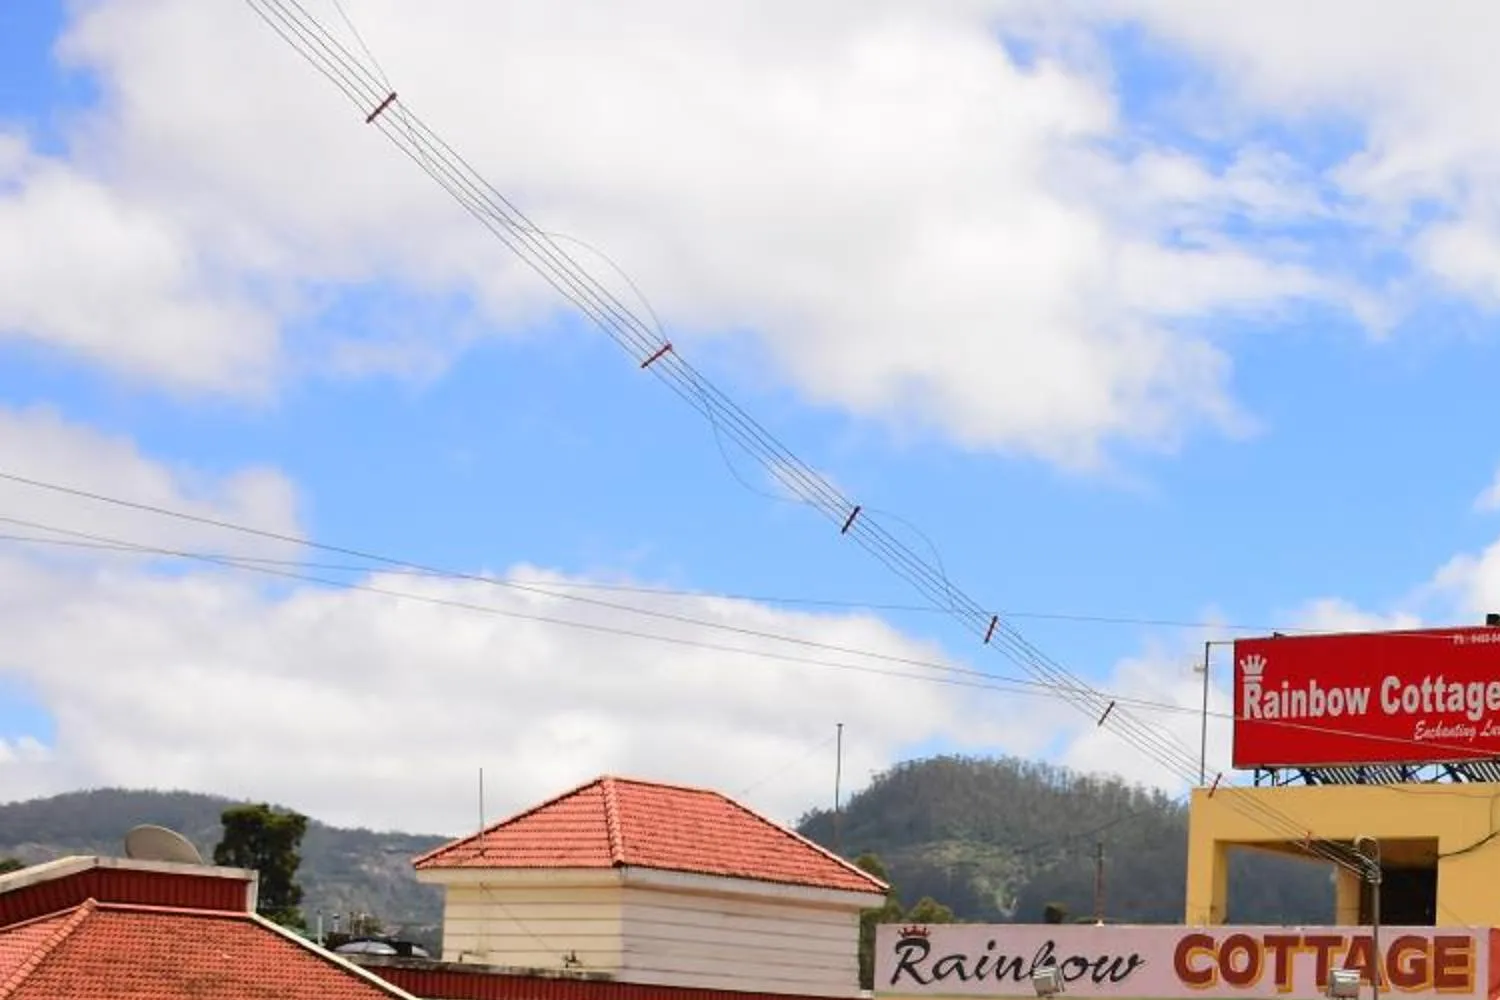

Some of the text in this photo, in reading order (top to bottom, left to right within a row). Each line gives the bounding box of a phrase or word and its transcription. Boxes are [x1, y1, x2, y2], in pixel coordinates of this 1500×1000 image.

[1242, 679, 1370, 720] Rainbow
[1414, 719, 1477, 742] Enchanting
[1173, 933, 1476, 993] COTTAGE
